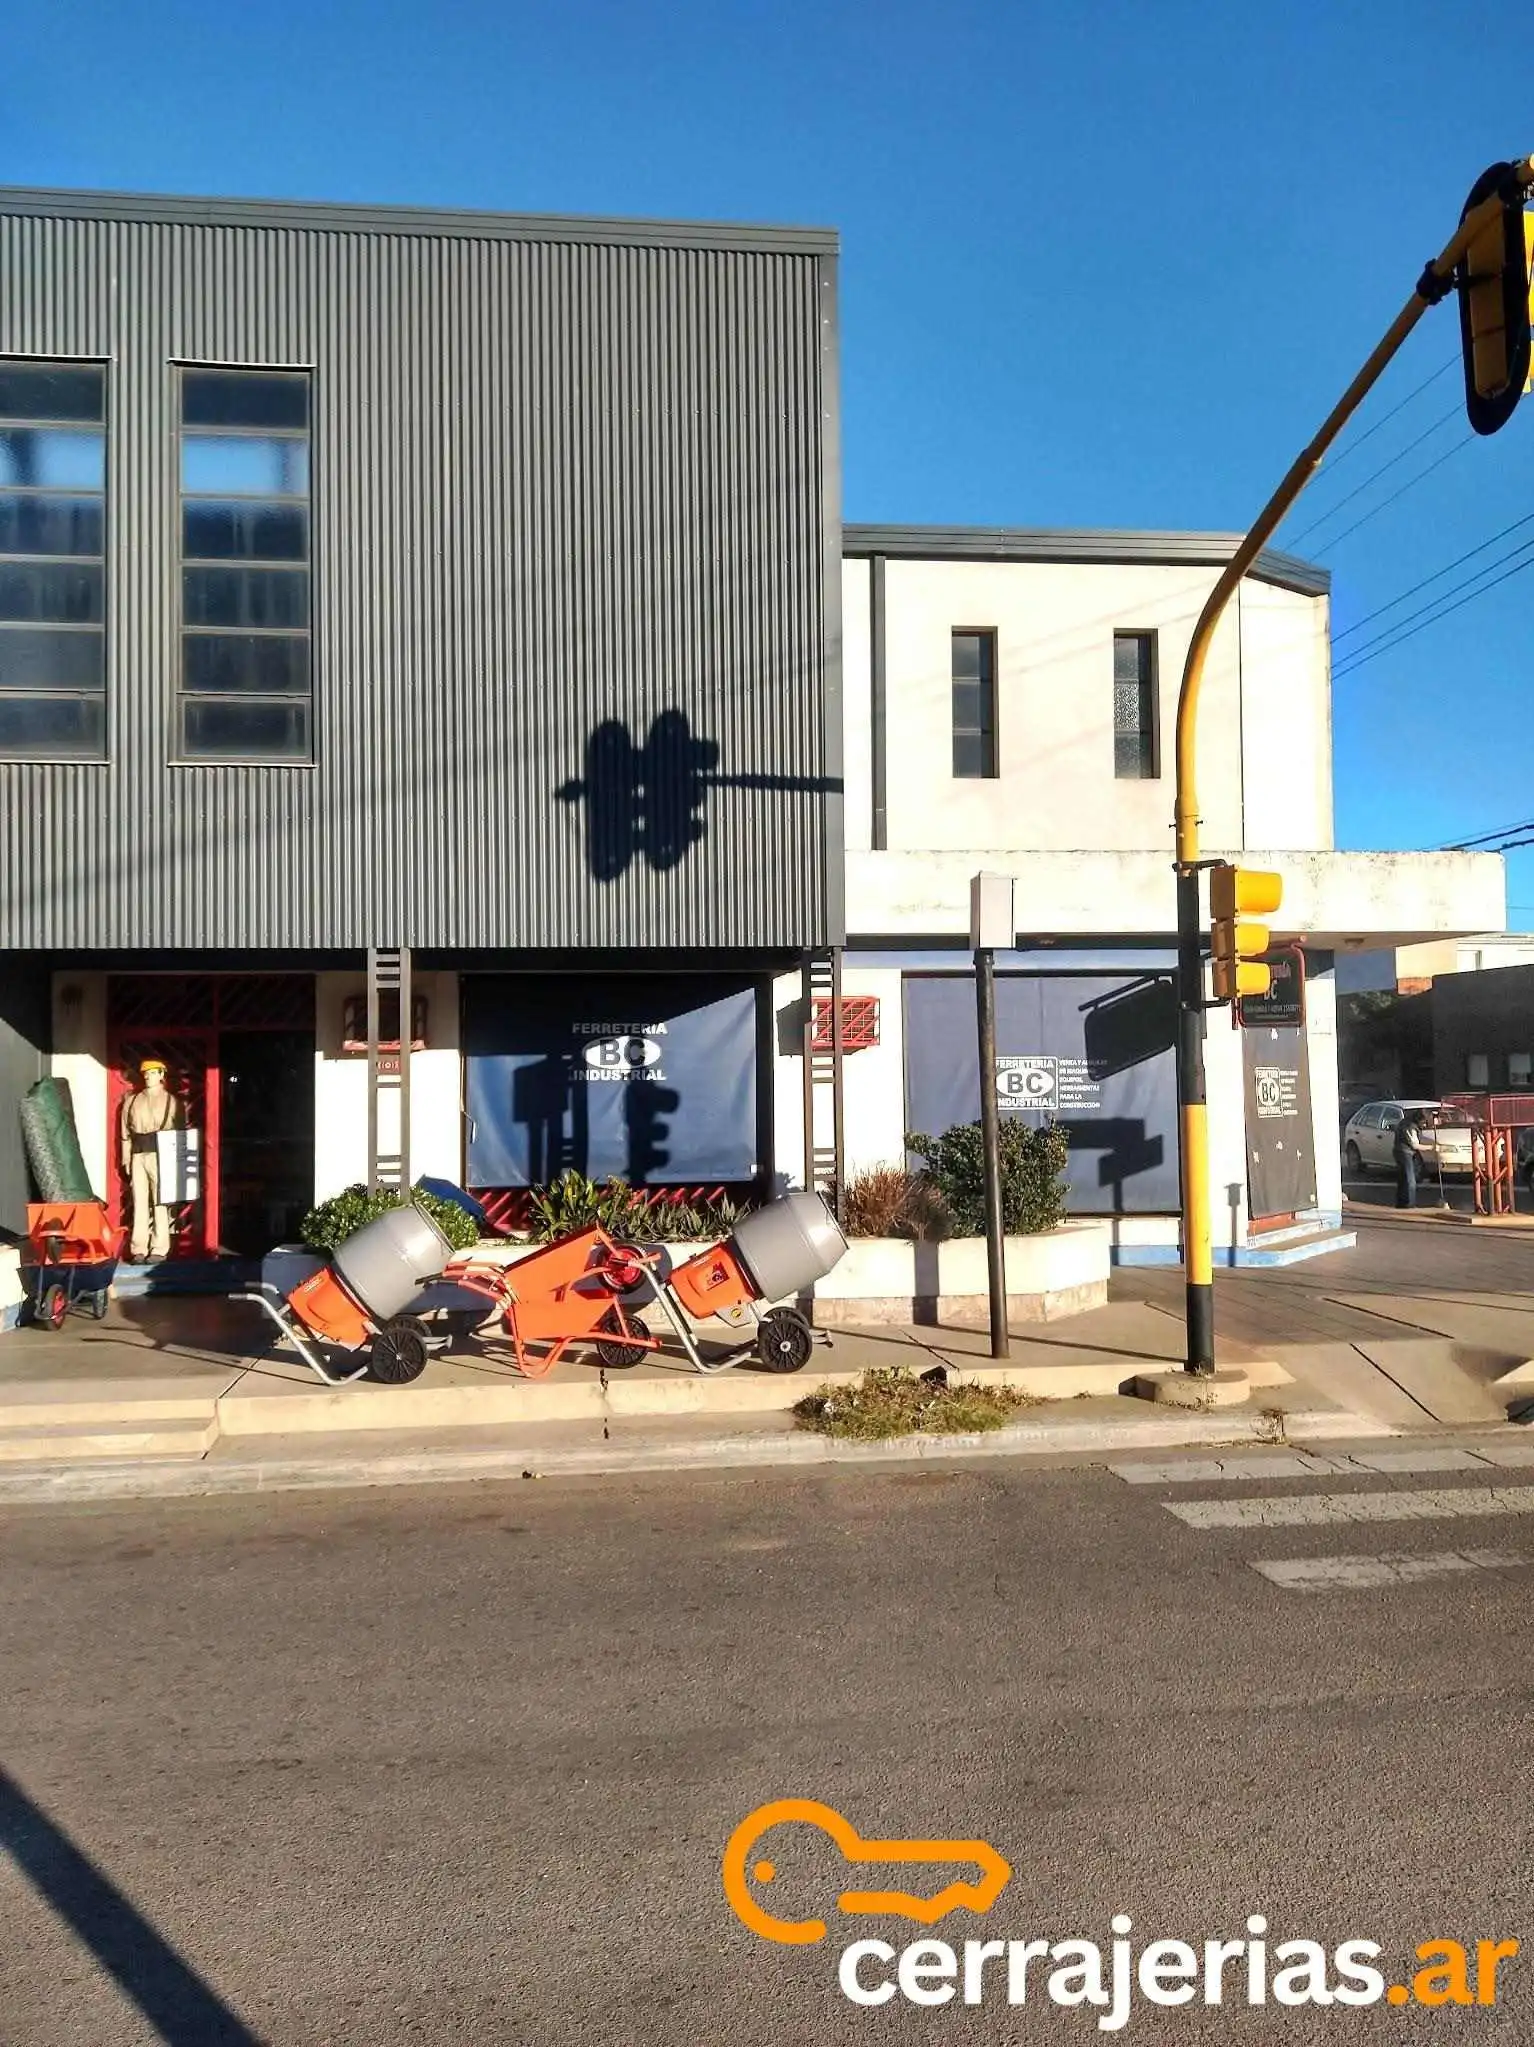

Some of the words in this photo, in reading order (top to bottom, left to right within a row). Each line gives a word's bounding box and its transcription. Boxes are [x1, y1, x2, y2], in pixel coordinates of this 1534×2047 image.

[572, 1022, 668, 1034] FERRETERIA
[599, 1038, 646, 1066] BC
[573, 1069, 667, 1081] INDUSTRIAL
[1007, 1072, 1043, 1094] BC
[1261, 1082, 1276, 1102] BC
[997, 1097, 1055, 1107] INDUSTRIAL
